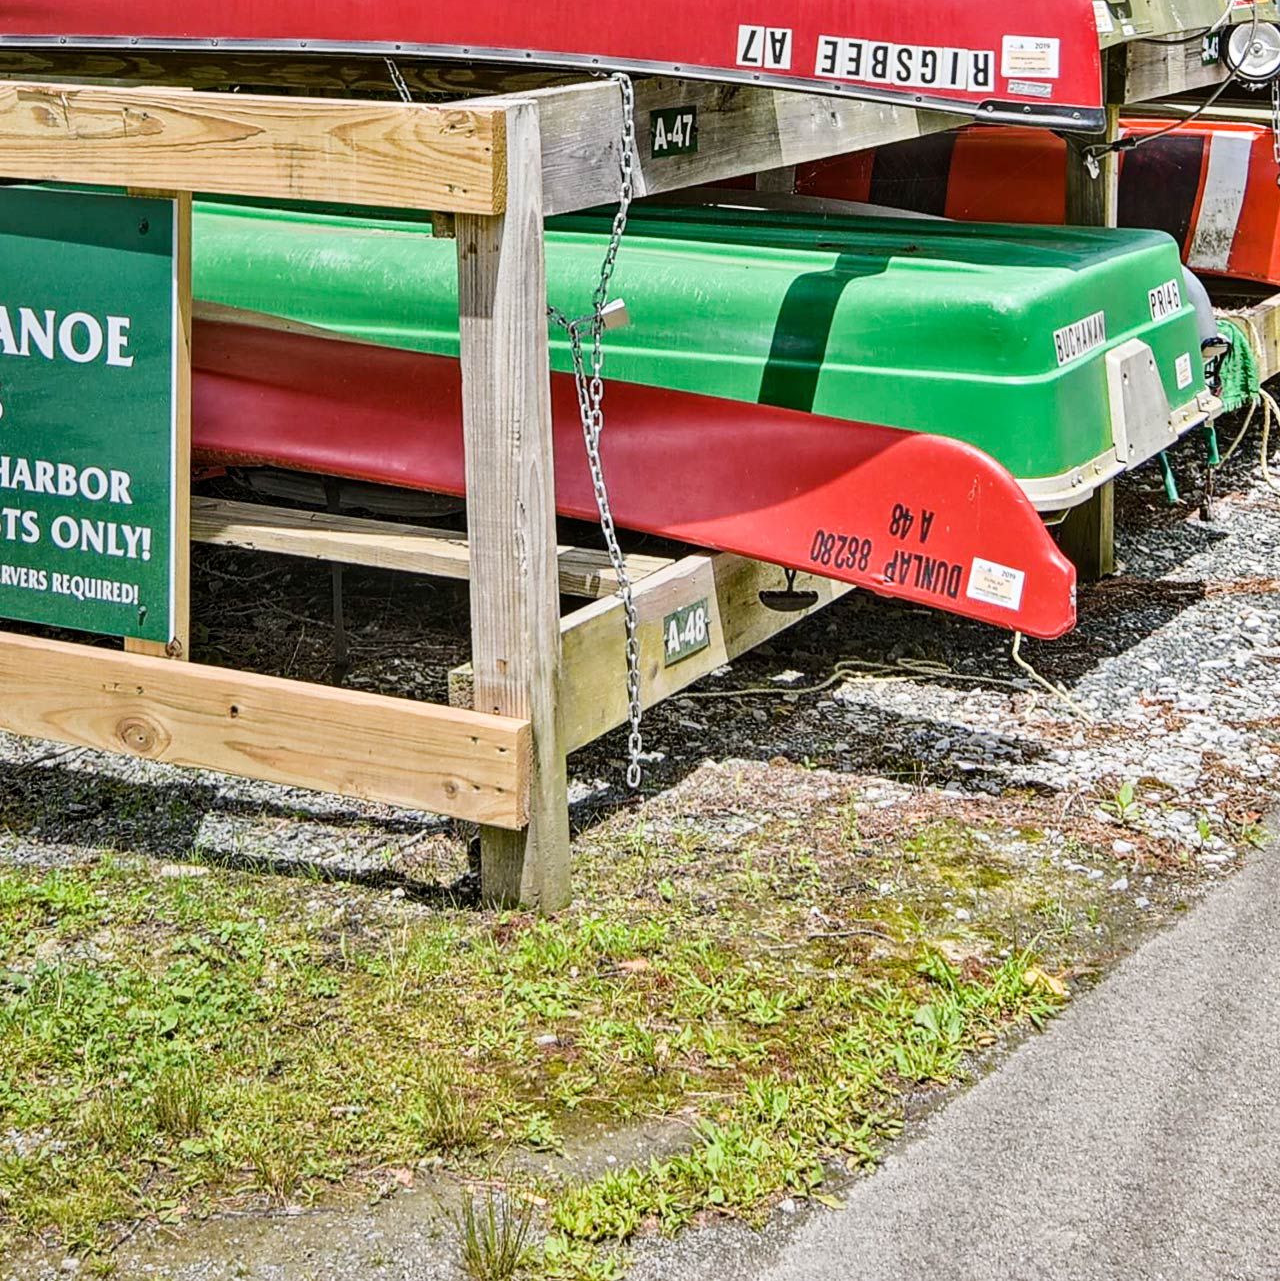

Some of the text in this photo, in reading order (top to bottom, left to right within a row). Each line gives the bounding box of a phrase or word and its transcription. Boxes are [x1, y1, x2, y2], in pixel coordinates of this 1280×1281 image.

[742, 30, 786, 65] A7
[823, 41, 990, 87] RIGSBEE
[654, 114, 693, 151] A-47
[1055, 313, 1105, 363] BUCHANAN
[51, 516, 152, 561] ONLY!
[889, 503, 934, 544] A 48
[51, 573, 139, 605] REQUIRED!
[882, 550, 962, 600] DUNLAP
[667, 606, 706, 655] A-48
